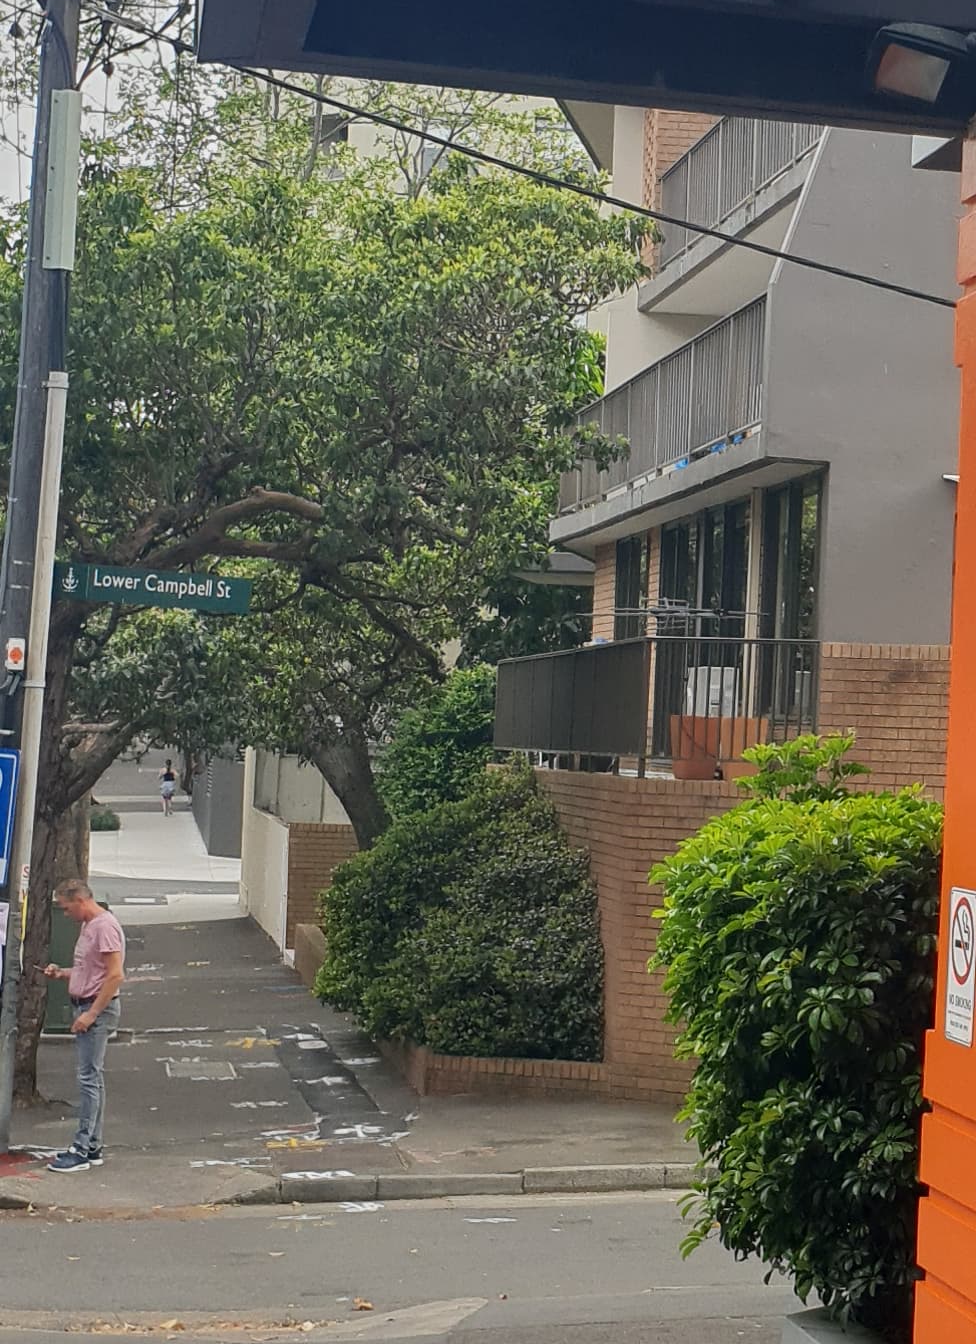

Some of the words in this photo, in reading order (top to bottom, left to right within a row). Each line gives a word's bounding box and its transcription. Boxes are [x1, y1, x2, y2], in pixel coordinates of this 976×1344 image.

[93, 569, 141, 590] Lower
[145, 574, 213, 599] Campbell
[216, 581, 231, 599] St
